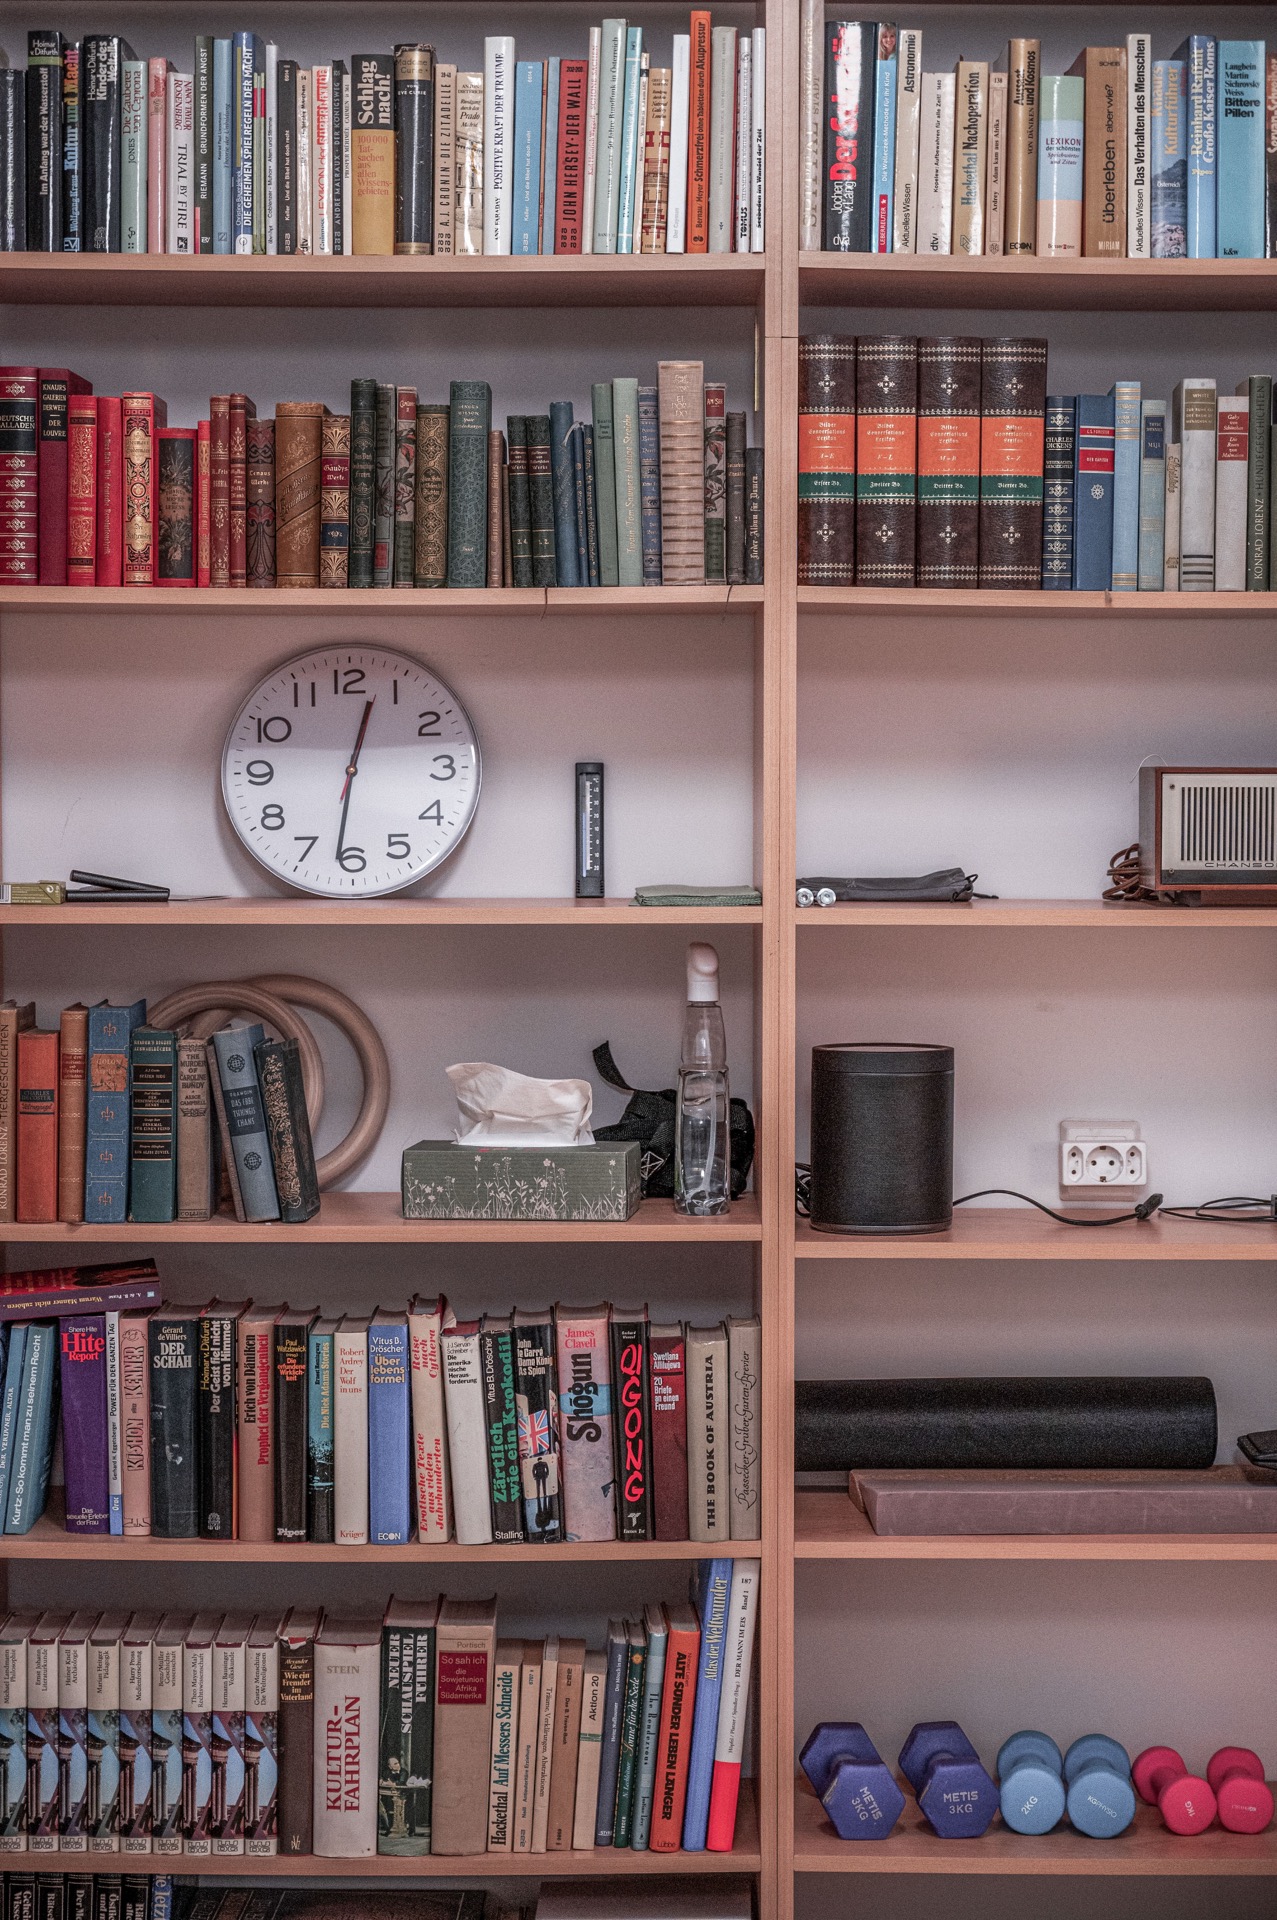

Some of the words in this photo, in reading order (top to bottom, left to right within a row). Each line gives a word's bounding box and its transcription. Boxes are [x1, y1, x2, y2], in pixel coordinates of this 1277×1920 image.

[96, 41, 107, 62] des
[243, 48, 252, 78] MACHT
[904, 34, 916, 92] Astronomie
[63, 50, 78, 93] Macht
[1025, 51, 1036, 86] Kosmos
[1134, 40, 1145, 93] Menschen
[1224, 63, 1256, 71] Langbein
[96, 64, 107, 100] Kinder
[122, 70, 131, 114] Zauberer
[243, 80, 252, 98] DER
[357, 61, 377, 124] Schlag
[568, 79, 581, 109] WALL
[375, 74, 390, 124] nach!
[1025, 87, 1034, 105] und
[1134, 95, 1145, 113] des
[1224, 98, 1260, 107] Bittere
[64, 97, 78, 123] und
[963, 72, 981, 149] Nachoperation
[1166, 67, 1178, 154] Kulturführer
[1224, 109, 1254, 117] Pillen
[122, 117, 131, 134] Die
[200, 94, 208, 154] GRUNDFORMEN
[243, 101, 252, 160] SPIELREGELN
[64, 126, 78, 170] Kultur
[1134, 115, 1145, 164] Verhalten
[177, 144, 187, 182] TRIAL
[1134, 166, 1145, 185] Das
[179, 185, 187, 197] BY
[200, 163, 208, 199] RIEMANN
[243, 161, 252, 206] GEHEIMEN
[961, 153, 977, 205] Hackethal
[177, 201, 187, 229] FIRE
[244, 208, 252, 225] DIE
[563, 192, 577, 222] JOHN
[1136, 189, 1144, 218] Wissen
[1136, 219, 1144, 252] Aktuelles
[1256, 386, 1265, 490] HUNDEGESCHICHTEN
[1255, 498, 1264, 535] LORENZ
[1255, 539, 1263, 579] KONRAD
[294, 682, 315, 707] 11
[334, 669, 366, 695] 12
[394, 680, 398, 704] 1
[257, 716, 291, 742] 10
[418, 711, 441, 736] 2
[246, 760, 274, 785] 9
[430, 755, 456, 781] 3
[261, 804, 285, 830] 8
[418, 799, 444, 826] 4
[294, 836, 319, 862] 7
[339, 847, 367, 872] 6
[387, 834, 410, 859] 5
[0, 1126, 8, 1165] LORENZ
[61, 1333, 105, 1352] Hite
[210, 1320, 220, 1345] nicht
[220, 1320, 231, 1361] Himmel
[565, 1328, 595, 1338] James
[565, 1339, 596, 1349] Clavell
[31, 1335, 42, 1365] Recht
[68, 1352, 99, 1362] Report
[154, 1355, 192, 1368] SCHAH
[161, 1343, 184, 1354] DER
[210, 1348, 220, 1364] fiel
[244, 1334, 256, 1376] Däniken
[340, 1348, 364, 1356] Robert
[370, 1345, 404, 1353] Dröscher
[375, 1356, 400, 1365] Über
[412, 1336, 420, 1370] Reise
[257, 1334, 270, 1406] Vergangenheit
[339, 1358, 363, 1366] Ardrey
[26, 1366, 39, 1404] seinem
[210, 1366, 221, 1390] Geist
[246, 1379, 255, 1395] von
[340, 1377, 356, 1385] Wolf
[370, 1374, 405, 1383] formel
[497, 1335, 516, 1425] Krokodil
[654, 1386, 672, 1394] Briefe
[705, 1355, 714, 1421] AUSTRIA
[26, 1405, 33, 1418] zu
[210, 1394, 220, 1412] Der
[244, 1398, 256, 1423] Erich
[257, 1407, 268, 1423] der
[655, 1402, 675, 1411] Freund
[22, 1418, 32, 1441] man
[706, 1425, 714, 1443] OF
[257, 1426, 270, 1465] Prophet
[505, 1430, 518, 1460] ein
[18, 1442, 30, 1478] kommt
[425, 1453, 434, 1488] vielen
[490, 1422, 508, 1502] Zärtlich
[706, 1449, 715, 1494] BOOK
[433, 1438, 444, 1530] Jahrhunderten
[507, 1465, 520, 1501] wie
[427, 1491, 435, 1513] aus
[707, 1500, 715, 1529] THE
[340, 1531, 364, 1539] Krüger
[706, 1577, 728, 1643] Weltwunder
[457, 1641, 486, 1649] Portisch
[708, 1644, 720, 1659] der
[327, 1666, 360, 1674] STEIN
[389, 1634, 400, 1689] NEUER
[704, 1661, 719, 1681] Atlas
[402, 1634, 413, 1734] SCHAUSPIEL
[441, 1676, 484, 1684] Sowjetunion
[495, 1671, 513, 1719] Schneide
[345, 1695, 360, 1812] FAHRPLAN
[493, 1722, 511, 1765] Messers
[326, 1705, 342, 1812] KULTUR-
[493, 1768, 509, 1787] Auf
[851, 1798, 869, 1821] 3KG
[860, 1787, 882, 1820] METIS
[943, 1791, 978, 1802] METIS
[949, 1804, 973, 1814] 3KG
[1020, 1795, 1038, 1815] 2KG
[1184, 1800, 1195, 1816] 1KG
[490, 1792, 509, 1845] Hackethal
